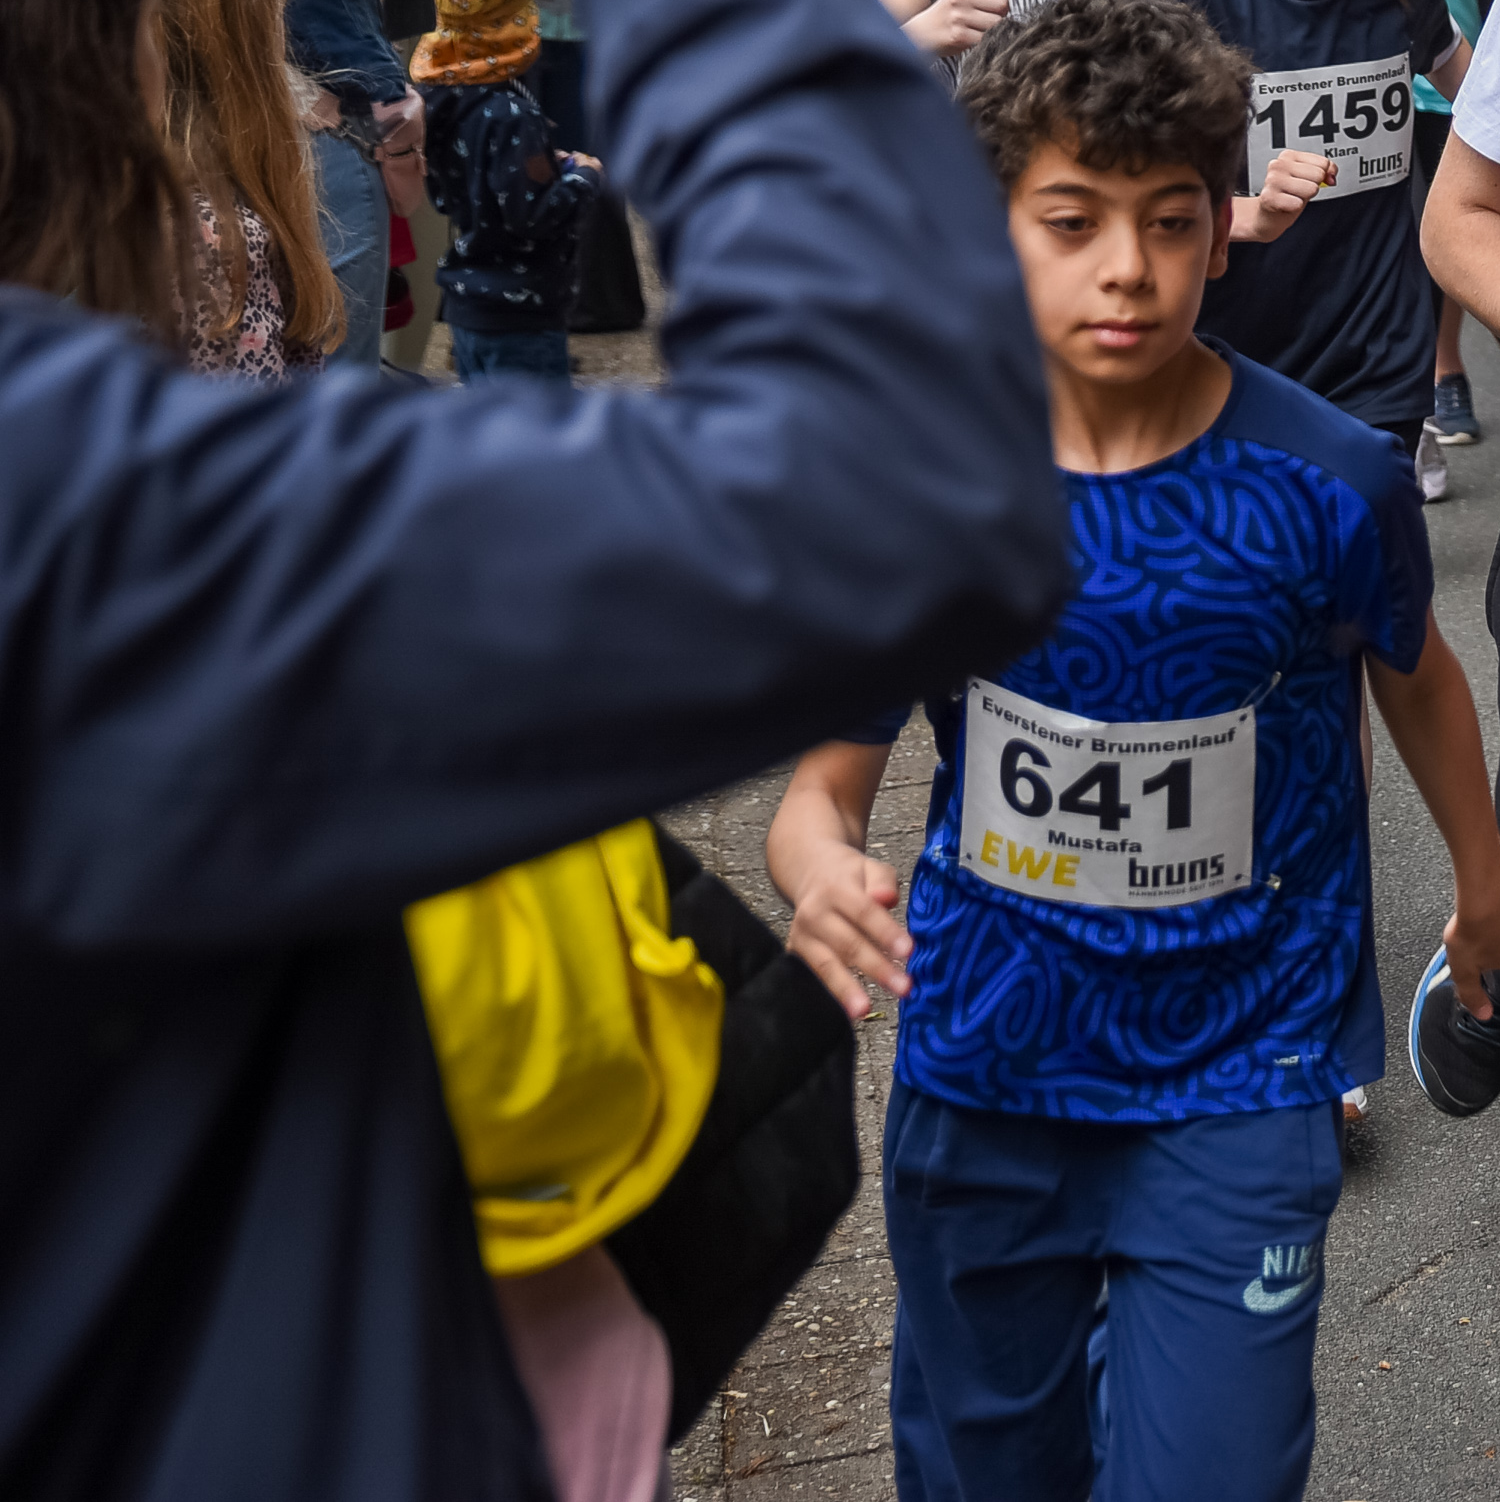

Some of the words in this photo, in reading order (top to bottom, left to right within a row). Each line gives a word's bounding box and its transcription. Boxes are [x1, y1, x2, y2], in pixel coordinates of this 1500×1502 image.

[1259, 79, 1334, 95] Everstener
[1337, 64, 1407, 87] Brunnenlauf
[1256, 81, 1412, 150] 1459
[1324, 146, 1359, 159] Klara
[1359, 151, 1403, 177] bruns
[982, 696, 1084, 750] Everstener
[1091, 727, 1237, 754] Brunnenlauf
[1000, 737, 1193, 832] 641
[980, 828, 1081, 888] EWE
[1047, 829, 1143, 853] Mustafa
[1128, 853, 1225, 888] bruns
